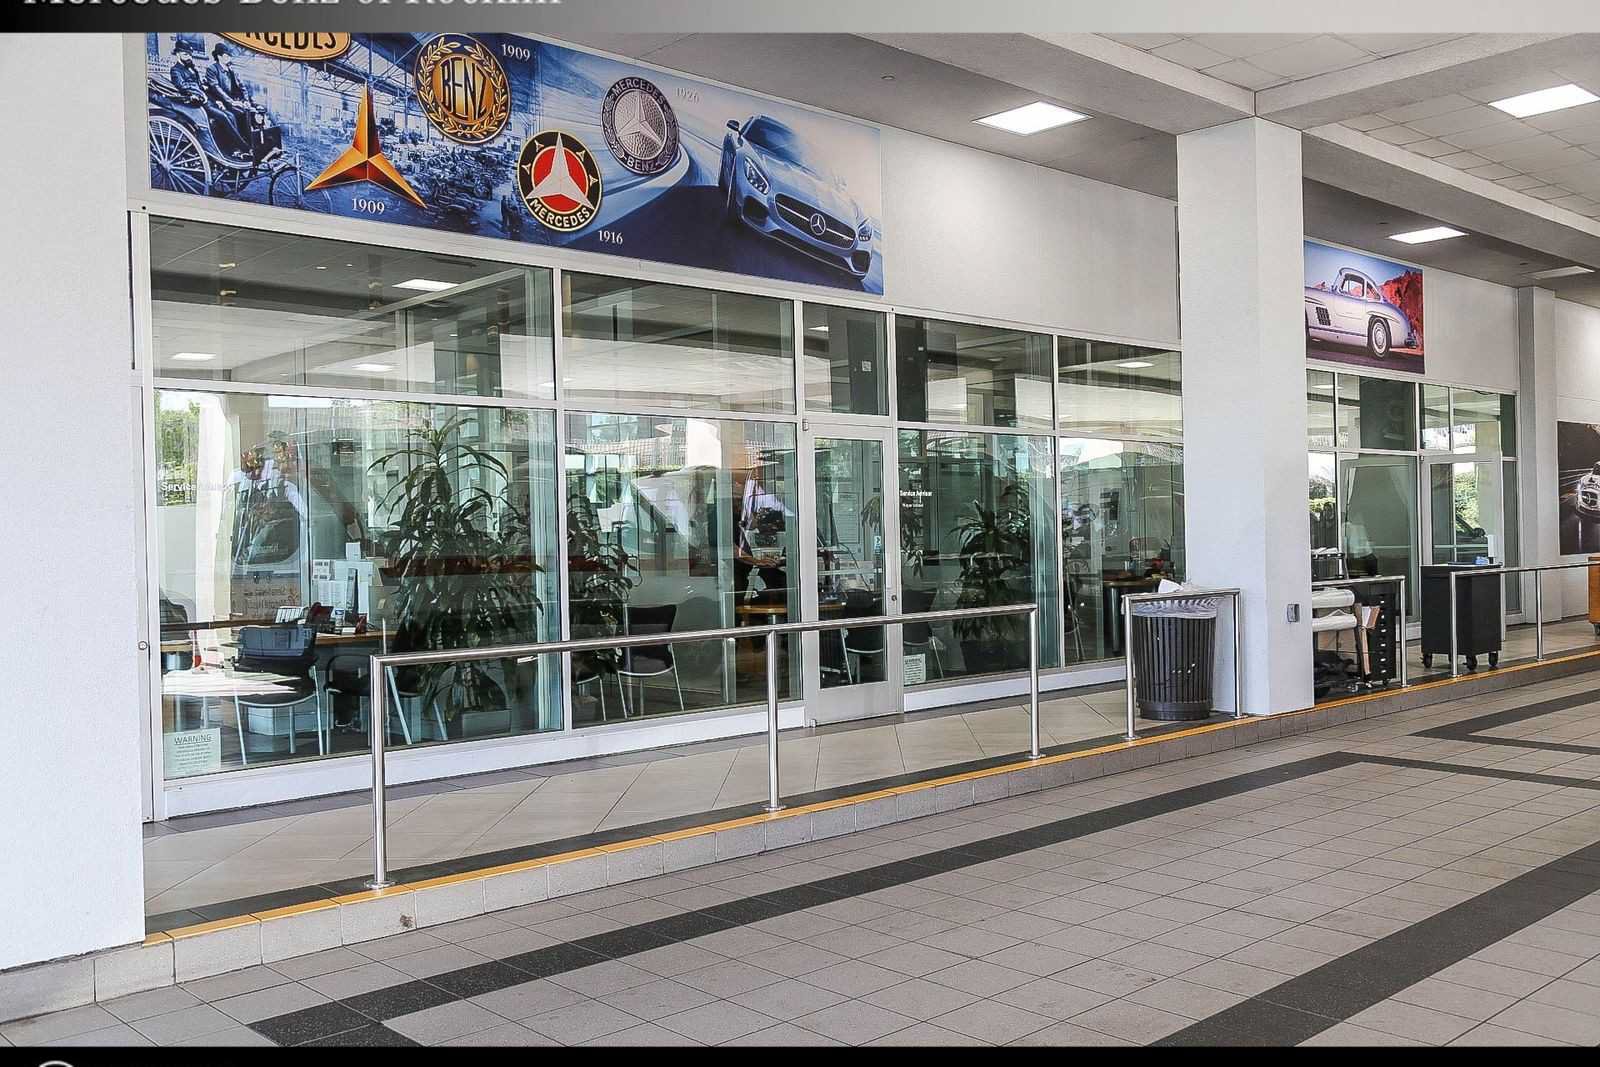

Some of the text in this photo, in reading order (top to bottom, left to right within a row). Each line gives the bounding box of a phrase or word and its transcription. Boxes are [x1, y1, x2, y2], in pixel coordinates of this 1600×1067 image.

[501, 43, 531, 61] 1909
[441, 57, 488, 120] BENZ
[613, 79, 664, 105] MERCEDES
[626, 157, 658, 172] BENZ
[352, 198, 385, 215] 1909
[529, 199, 590, 228] MERCEDES
[598, 230, 624, 245] 1916
[174, 733, 212, 745] WARNING
